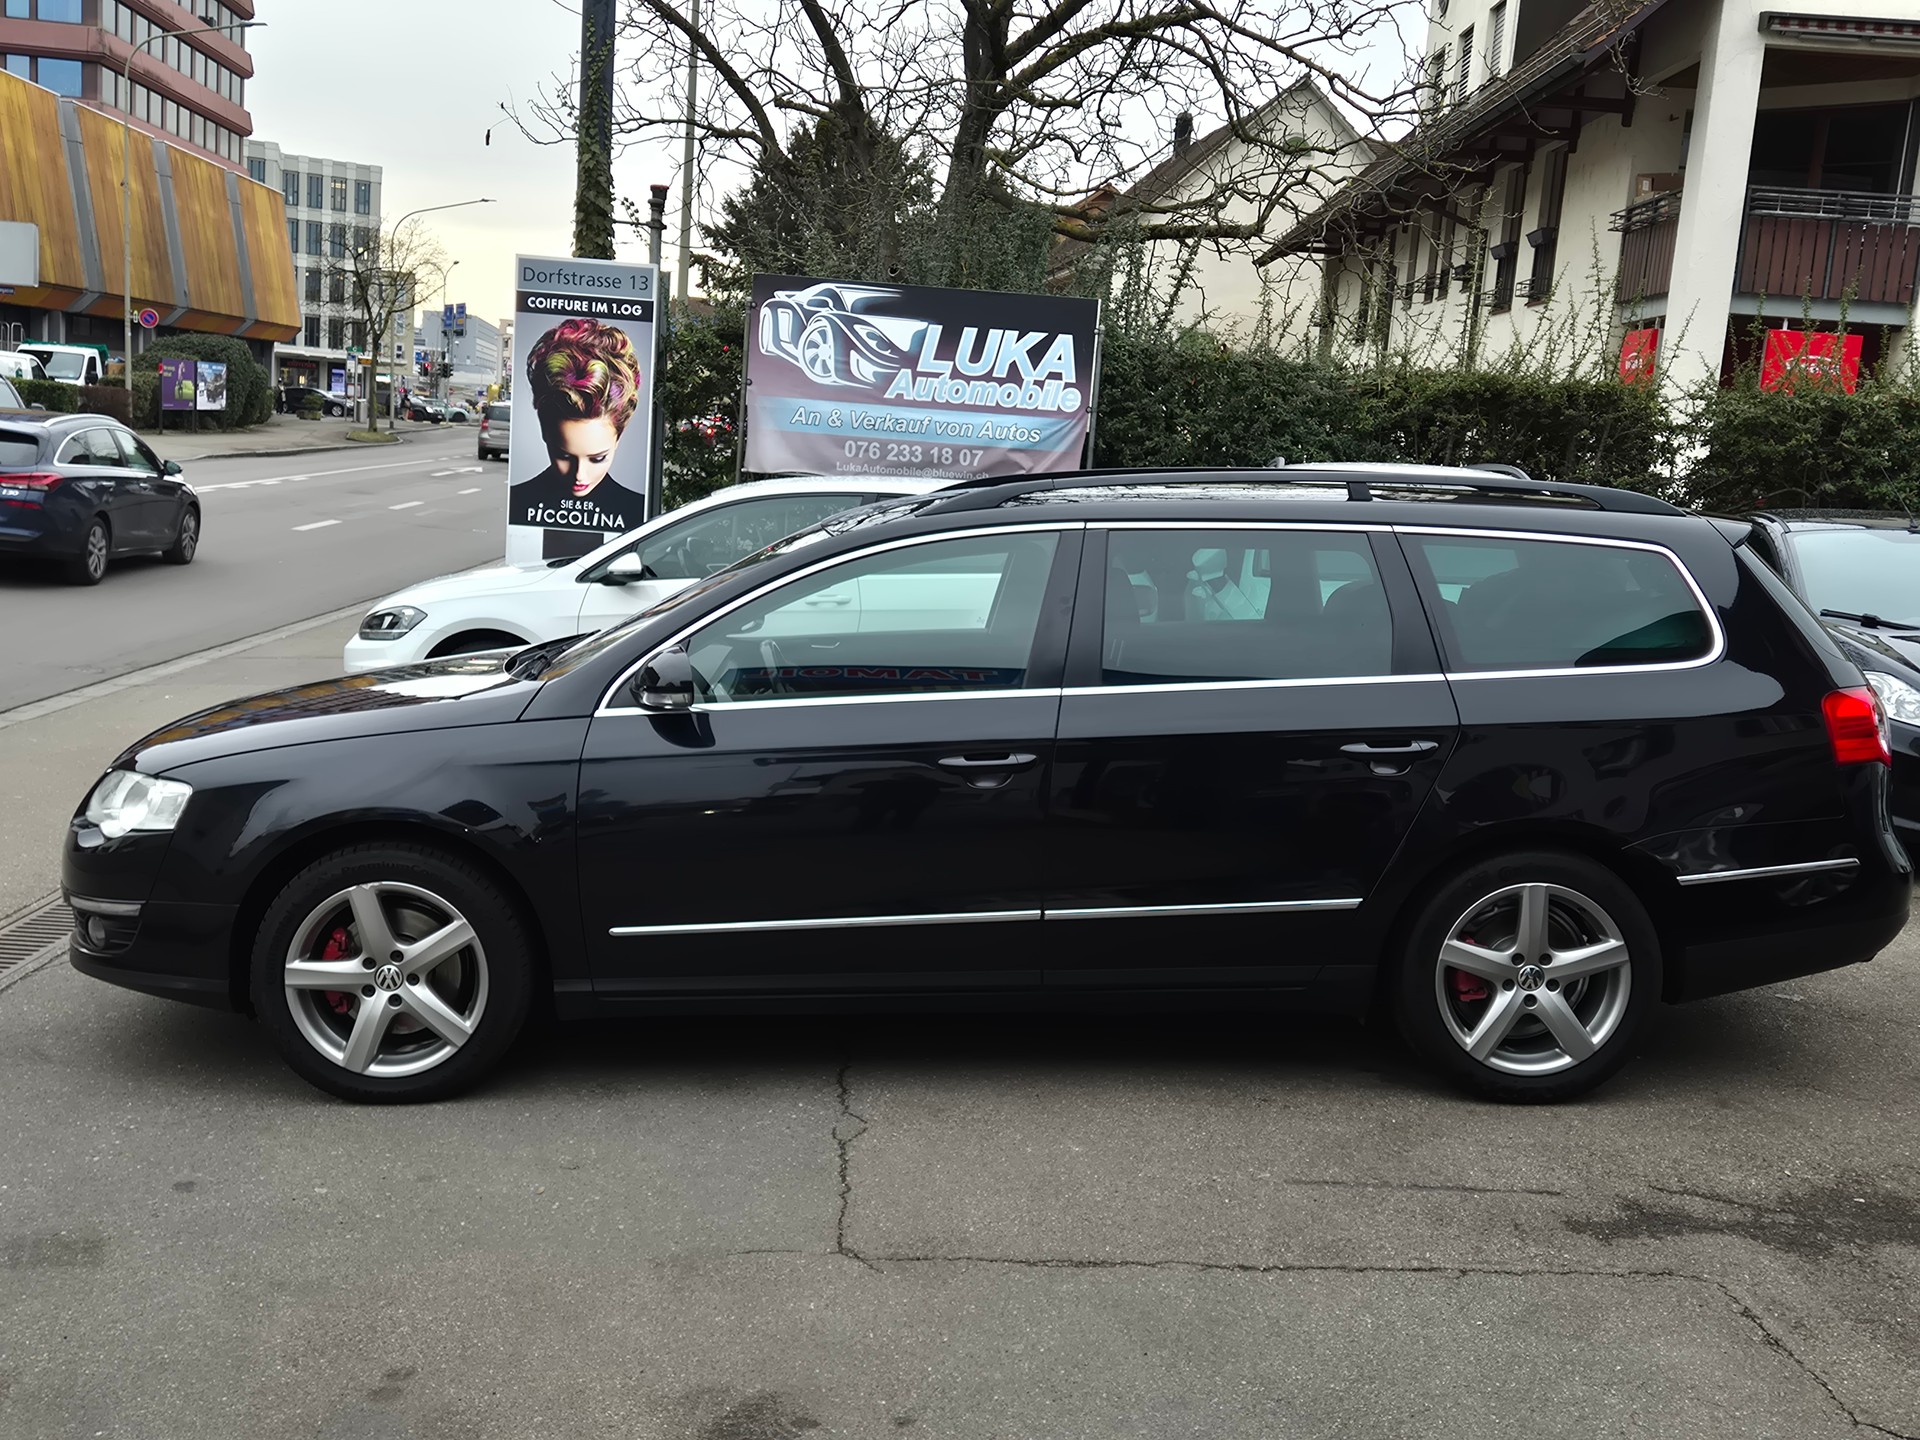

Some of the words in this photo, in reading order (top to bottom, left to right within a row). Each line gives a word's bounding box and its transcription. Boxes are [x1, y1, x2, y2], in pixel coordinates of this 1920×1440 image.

[523, 266, 622, 289] Dorfstrasse
[629, 275, 649, 291] 13
[527, 296, 589, 312] COIFFURE
[592, 301, 608, 314] IM
[611, 303, 643, 316] 1.OG
[916, 324, 1077, 383] LUKA
[883, 368, 1082, 413] Automobile
[790, 406, 821, 426] An
[827, 408, 844, 428] &
[850, 410, 932, 435] Verkauf
[935, 422, 974, 438] von
[977, 421, 1042, 443] Autos
[844, 440, 881, 460] 076
[886, 442, 923, 464] 233
[930, 446, 953, 465] 18
[959, 449, 984, 468] 07
[560, 499, 574, 509] SIE
[574, 500, 582, 510] &
[583, 501, 594, 511] ER
